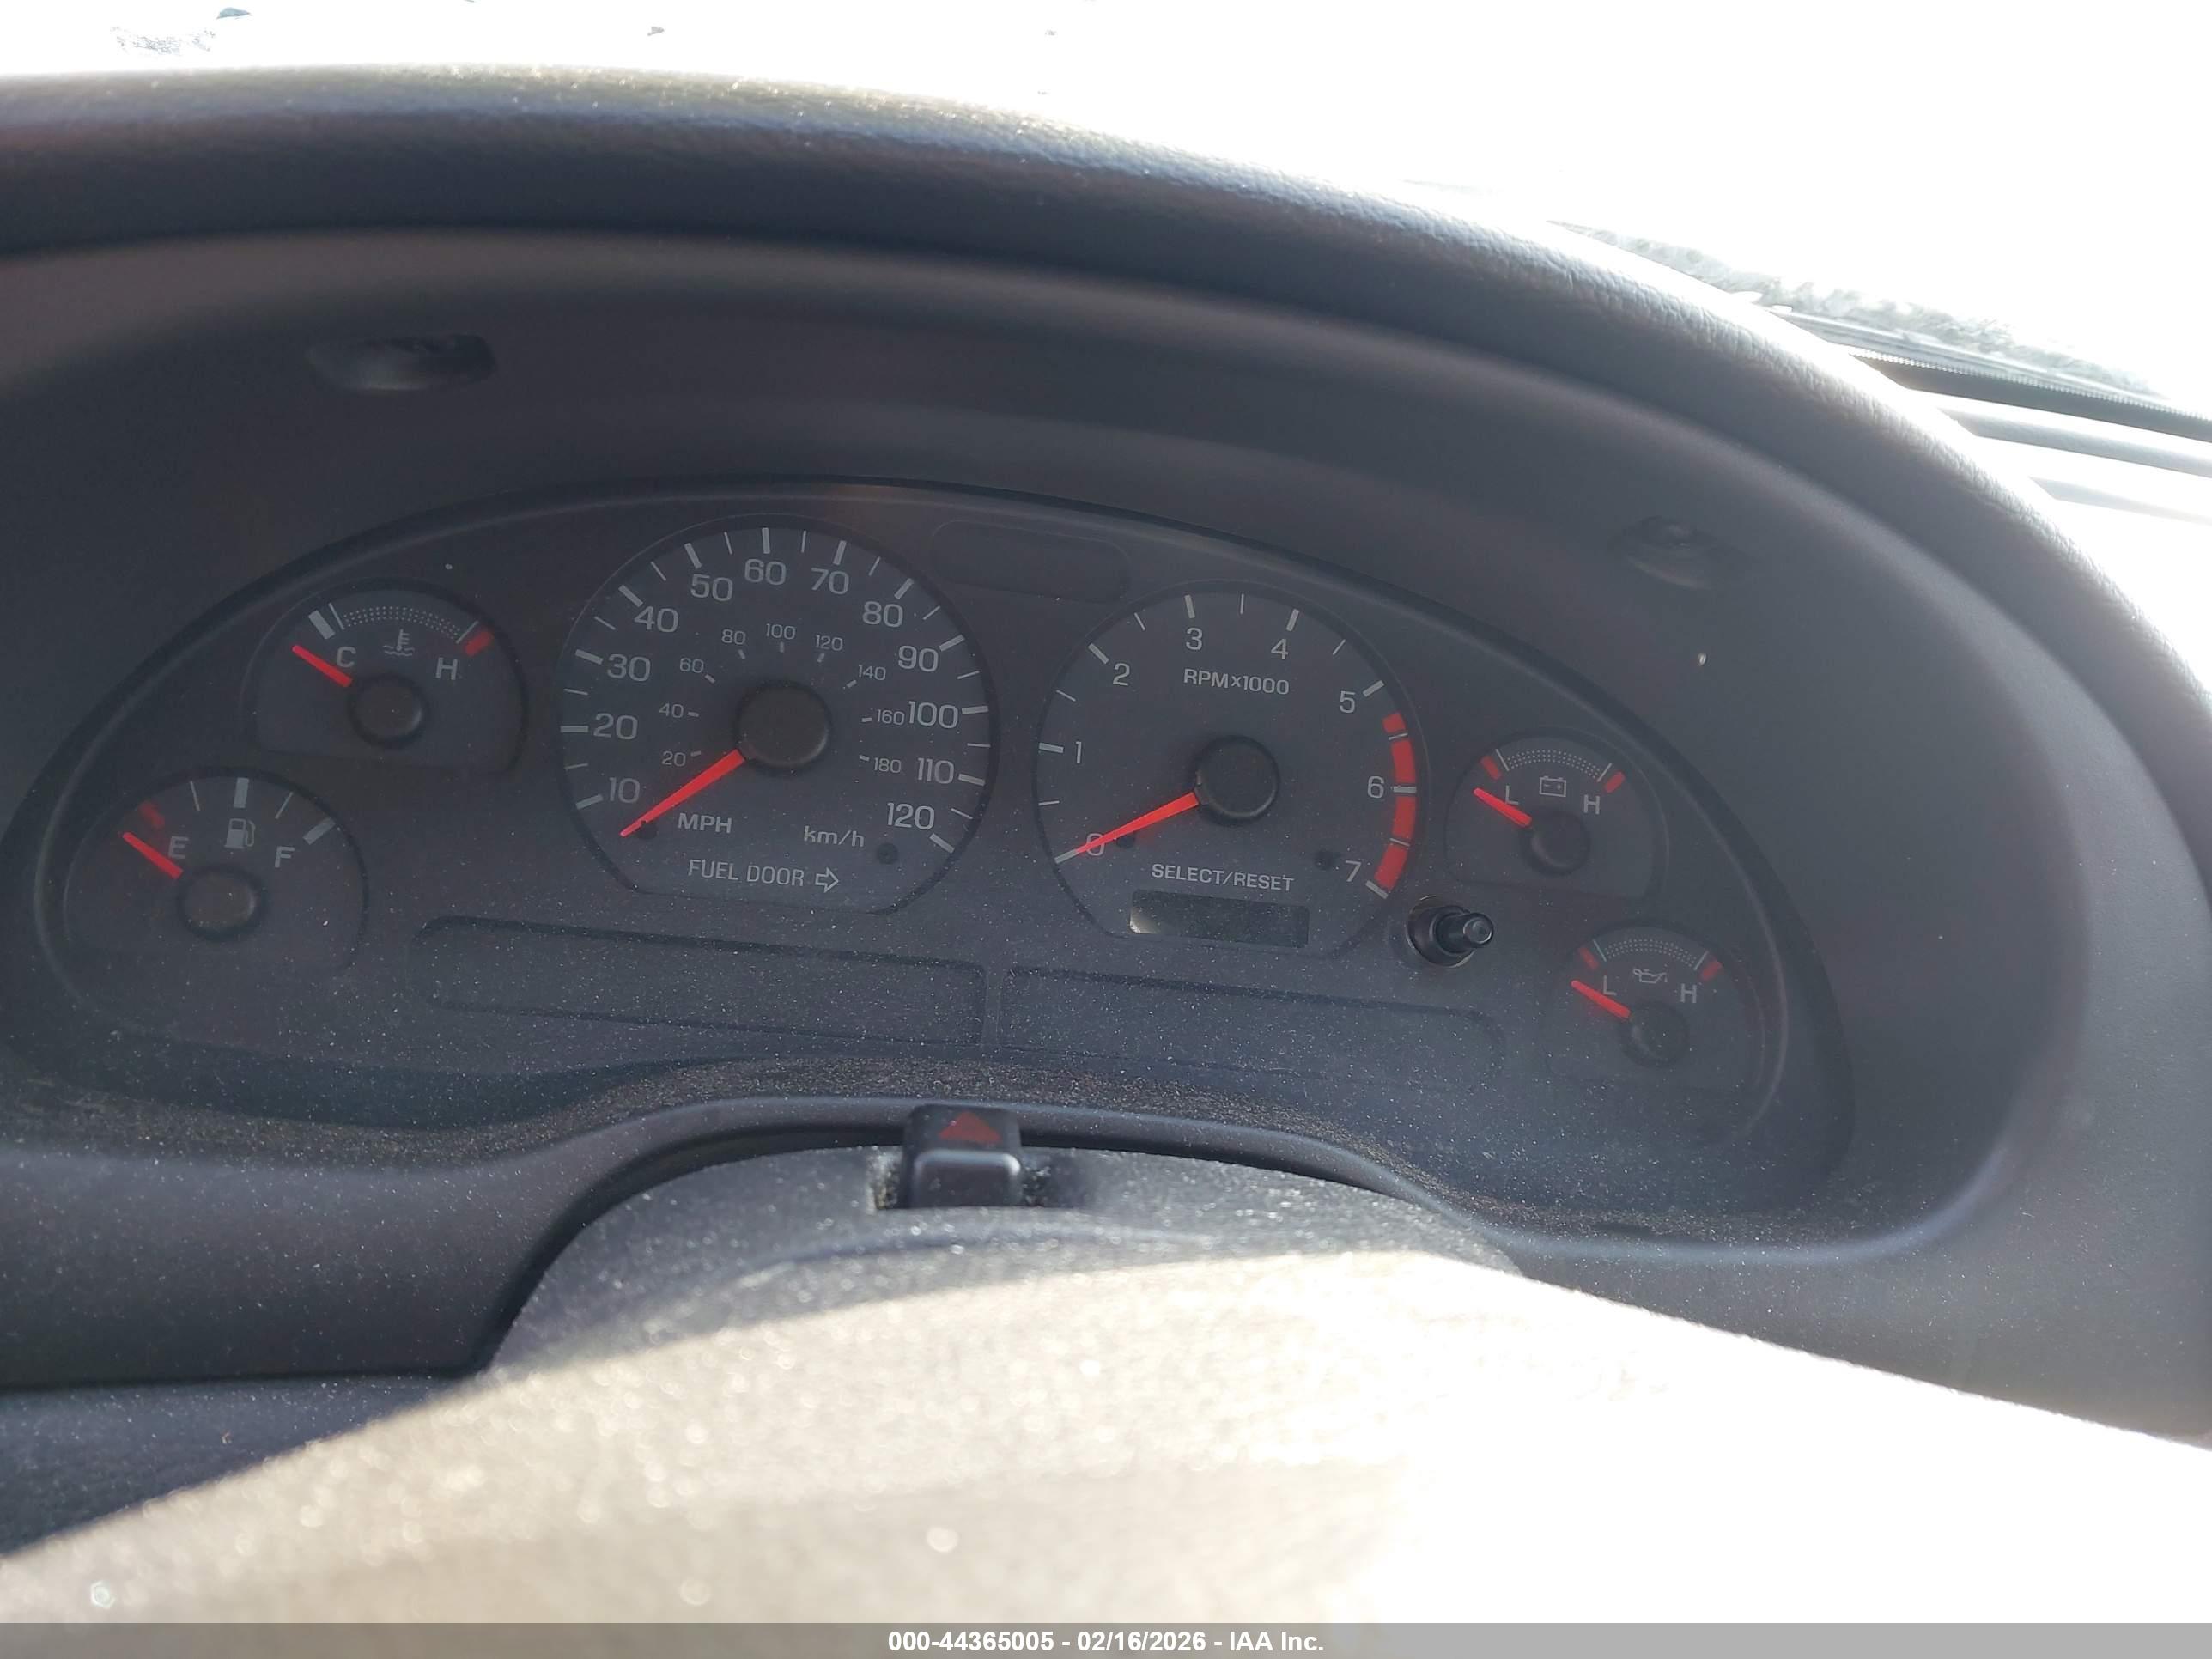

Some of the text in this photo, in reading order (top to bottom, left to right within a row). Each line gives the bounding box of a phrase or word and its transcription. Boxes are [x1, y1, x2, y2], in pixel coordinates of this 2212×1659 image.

[744, 559, 787, 586] 60
[811, 568, 850, 595] 70
[690, 576, 733, 602] 50
[634, 607, 679, 633] 40
[862, 601, 903, 628] 80
[721, 629, 747, 646] 80
[765, 623, 797, 640] 100
[1185, 627, 1203, 651] 3
[814, 635, 843, 652] 120
[1271, 639, 1289, 659] 4
[337, 647, 357, 669] C
[435, 658, 459, 680] H
[607, 654, 651, 682] 30
[679, 659, 704, 674] 60
[897, 646, 939, 672] 90
[858, 665, 886, 681] 140
[1113, 664, 1130, 686] 2
[659, 703, 684, 719] 40
[1339, 690, 1356, 713] 5
[876, 709, 905, 726] 160
[908, 702, 959, 729] 100
[592, 714, 638, 740] 20
[661, 750, 686, 767] 20
[1073, 741, 1084, 763] 1
[873, 758, 902, 774] 180
[915, 758, 955, 784] 110
[608, 777, 641, 804] 10
[1367, 776, 1385, 798] 6
[1505, 785, 1519, 805] L
[1583, 795, 1601, 815] H
[678, 813, 732, 834] MPH
[886, 803, 934, 830] 120
[169, 836, 190, 860] E
[803, 826, 865, 848] km/h
[275, 845, 296, 868] F
[688, 860, 805, 887] FUEL DOOR
[1151, 864, 1294, 892] SELECT/RESET
[1345, 860, 1363, 883] 7
[1602, 975, 1617, 996] L
[1680, 984, 1698, 1003] H
